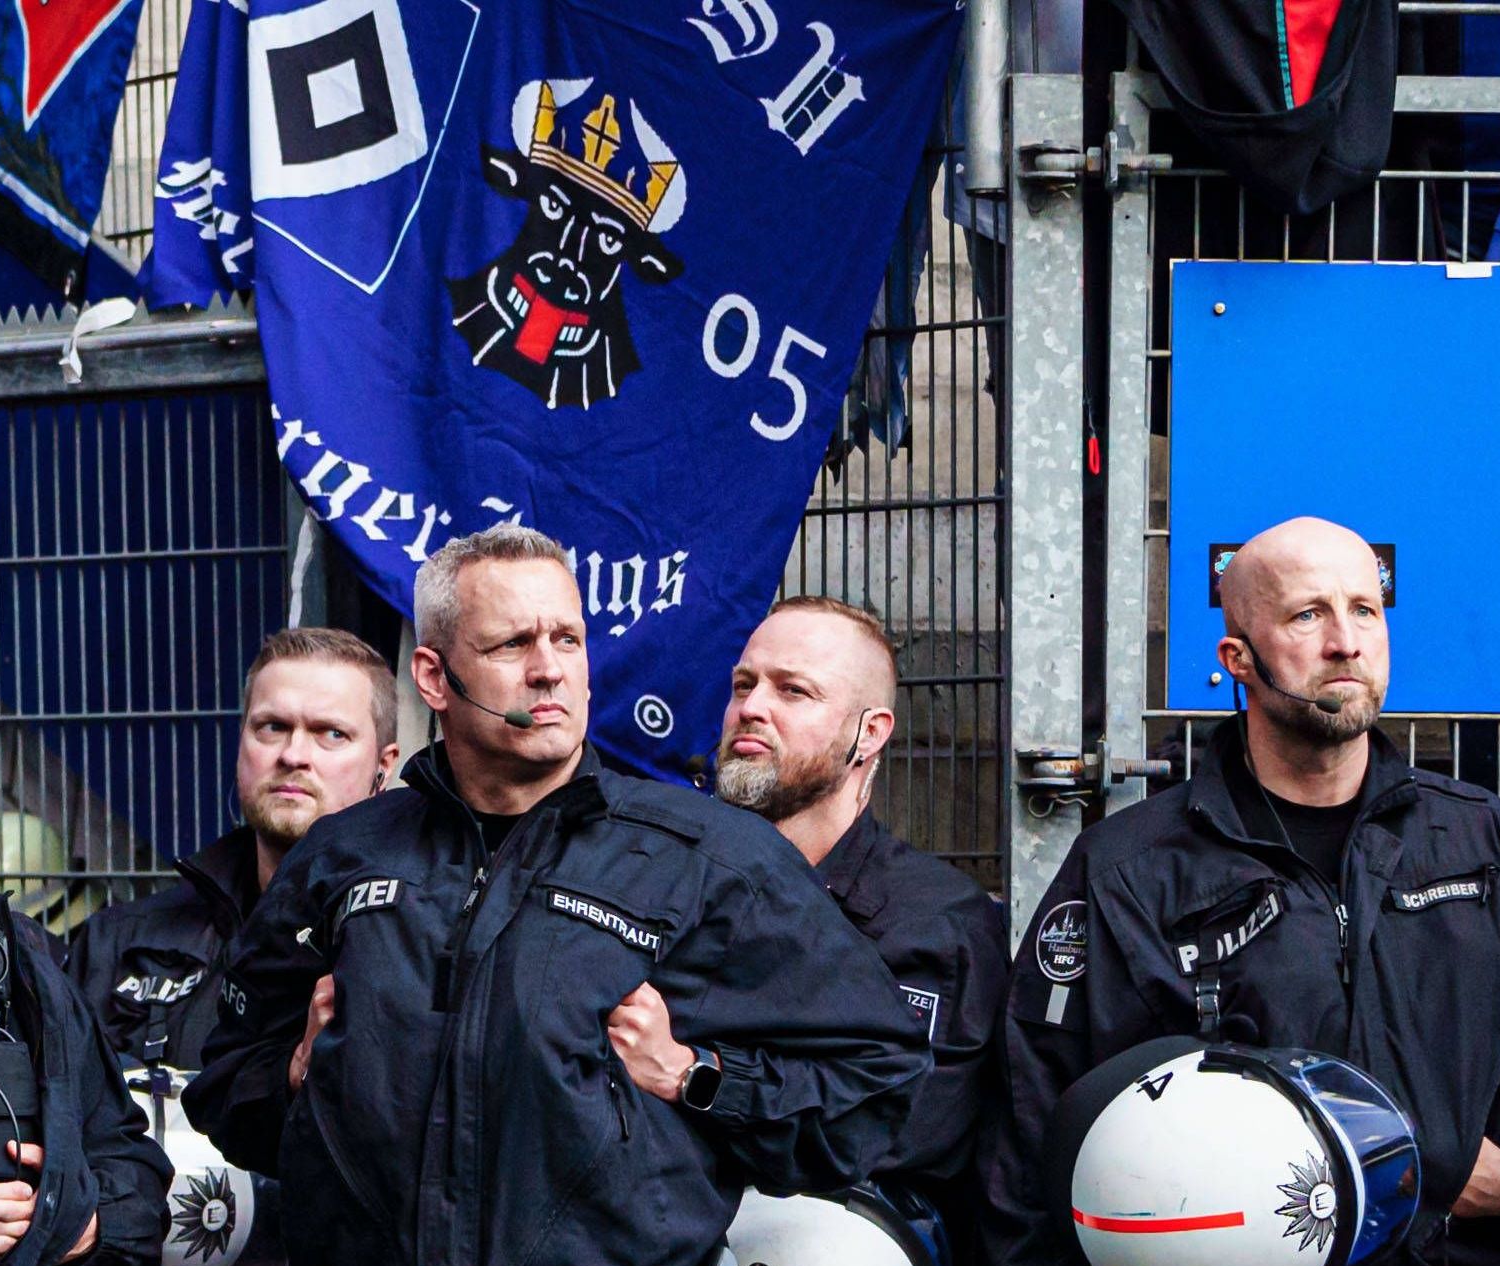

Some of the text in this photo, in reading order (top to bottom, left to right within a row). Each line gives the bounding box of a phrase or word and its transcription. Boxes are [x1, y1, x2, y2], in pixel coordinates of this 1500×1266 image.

[702, 293, 827, 441] 05
[1402, 882, 1479, 908] SCHREIBER
[553, 893, 660, 949] EHRENTRAUT
[1053, 954, 1076, 965] HFG
